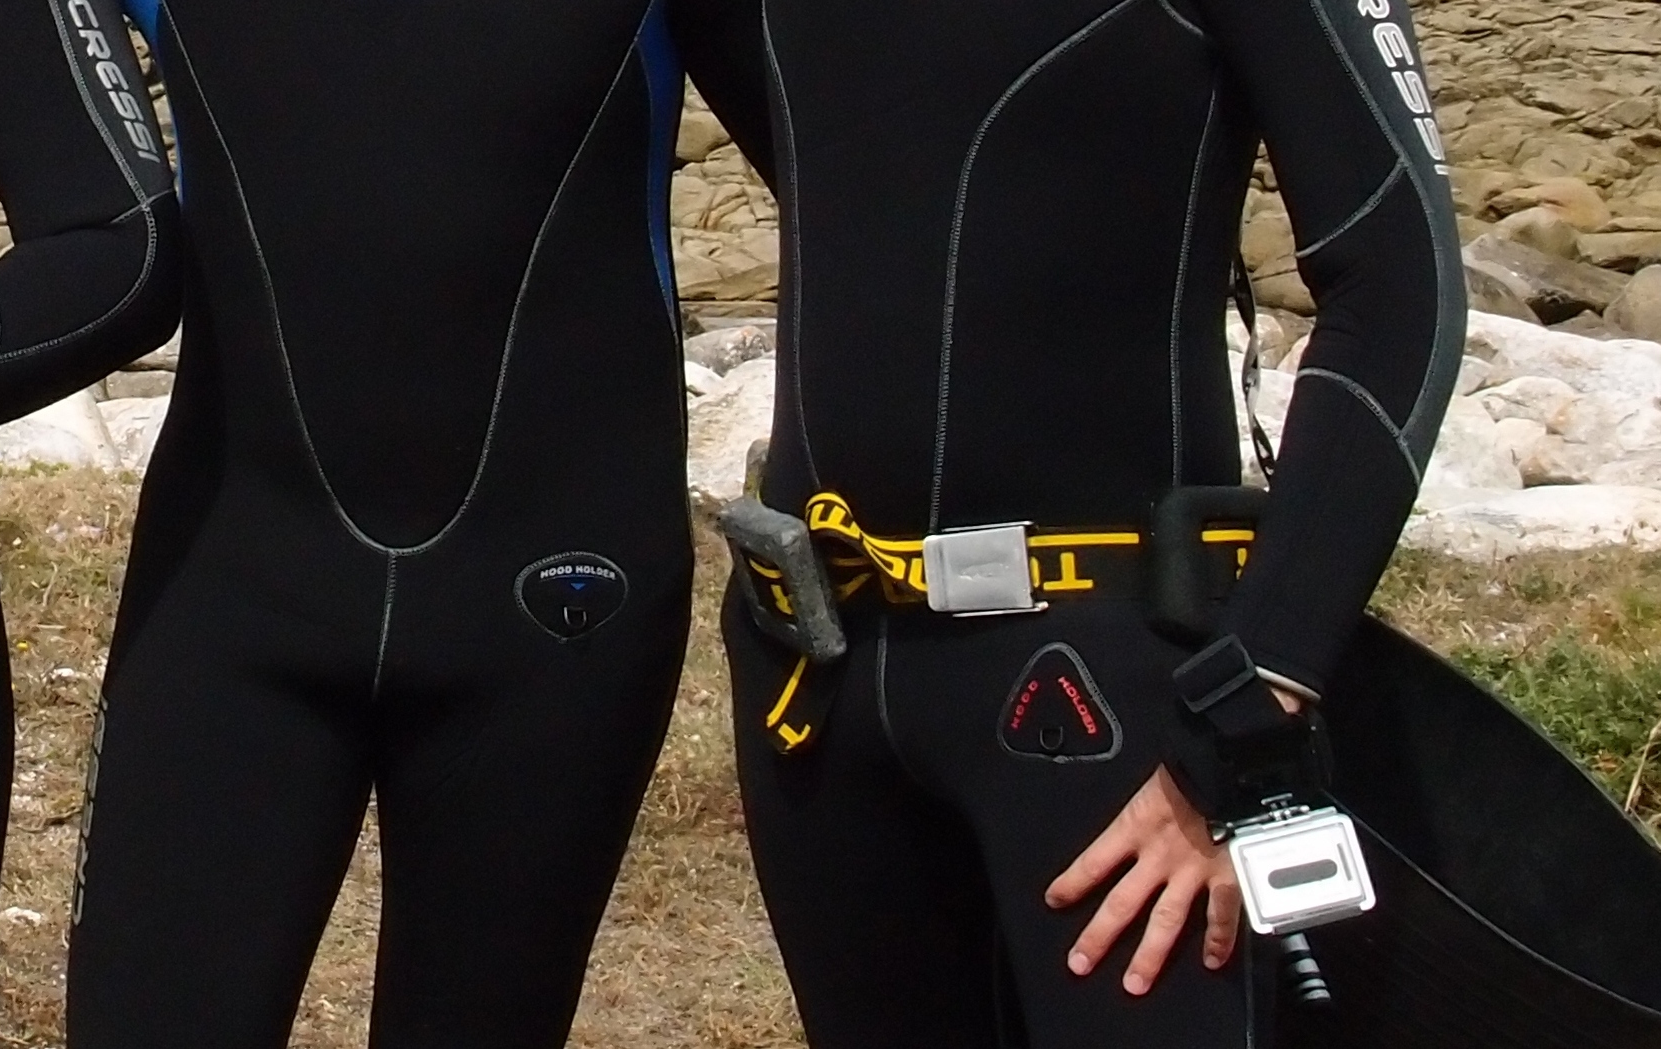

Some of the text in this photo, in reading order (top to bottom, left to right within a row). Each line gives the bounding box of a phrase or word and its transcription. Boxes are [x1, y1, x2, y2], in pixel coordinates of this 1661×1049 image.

[539, 564, 617, 581] HOOD HOLDER
[1011, 676, 1097, 735] HOOD HOLDER
